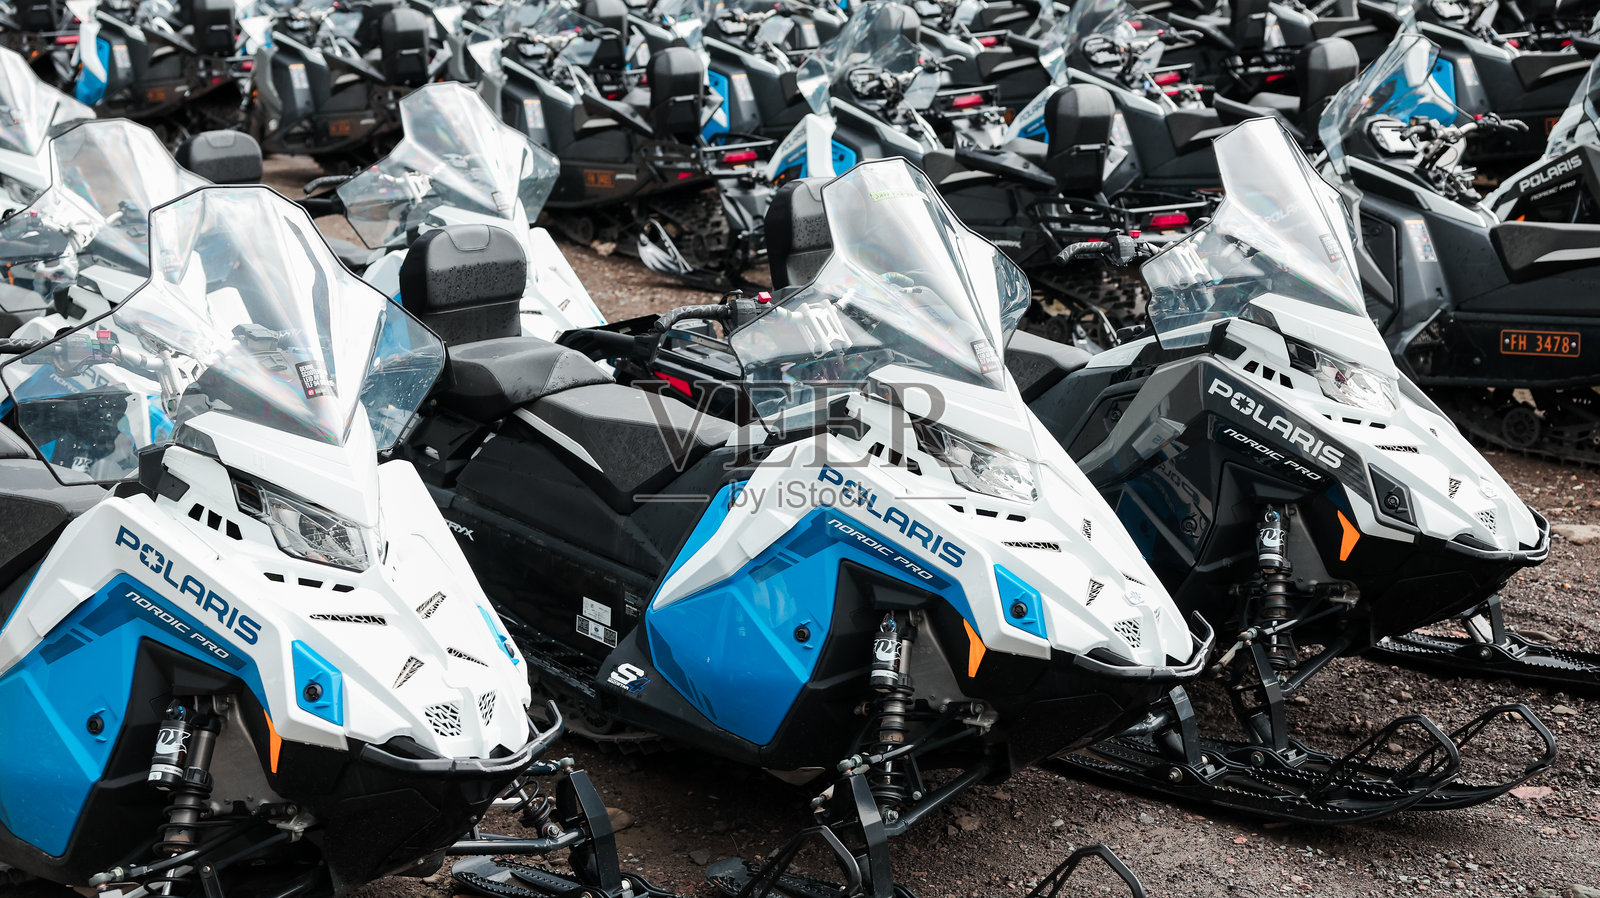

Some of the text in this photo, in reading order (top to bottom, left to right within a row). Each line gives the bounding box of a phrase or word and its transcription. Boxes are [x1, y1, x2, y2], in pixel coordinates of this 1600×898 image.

[1519, 155, 1582, 192] POLARIS
[1510, 334, 1570, 354] FH 3478
[1208, 378, 1345, 469] POLARIS
[1223, 428, 1322, 481] NORDIC PRO
[444, 518, 475, 541] RYX
[817, 463, 966, 568] POLARIS
[827, 519, 933, 580] NORDIC PRO
[115, 524, 262, 646] POLARIS
[125, 591, 230, 659] NORDIC PRO
[156, 728, 191, 754] OX
